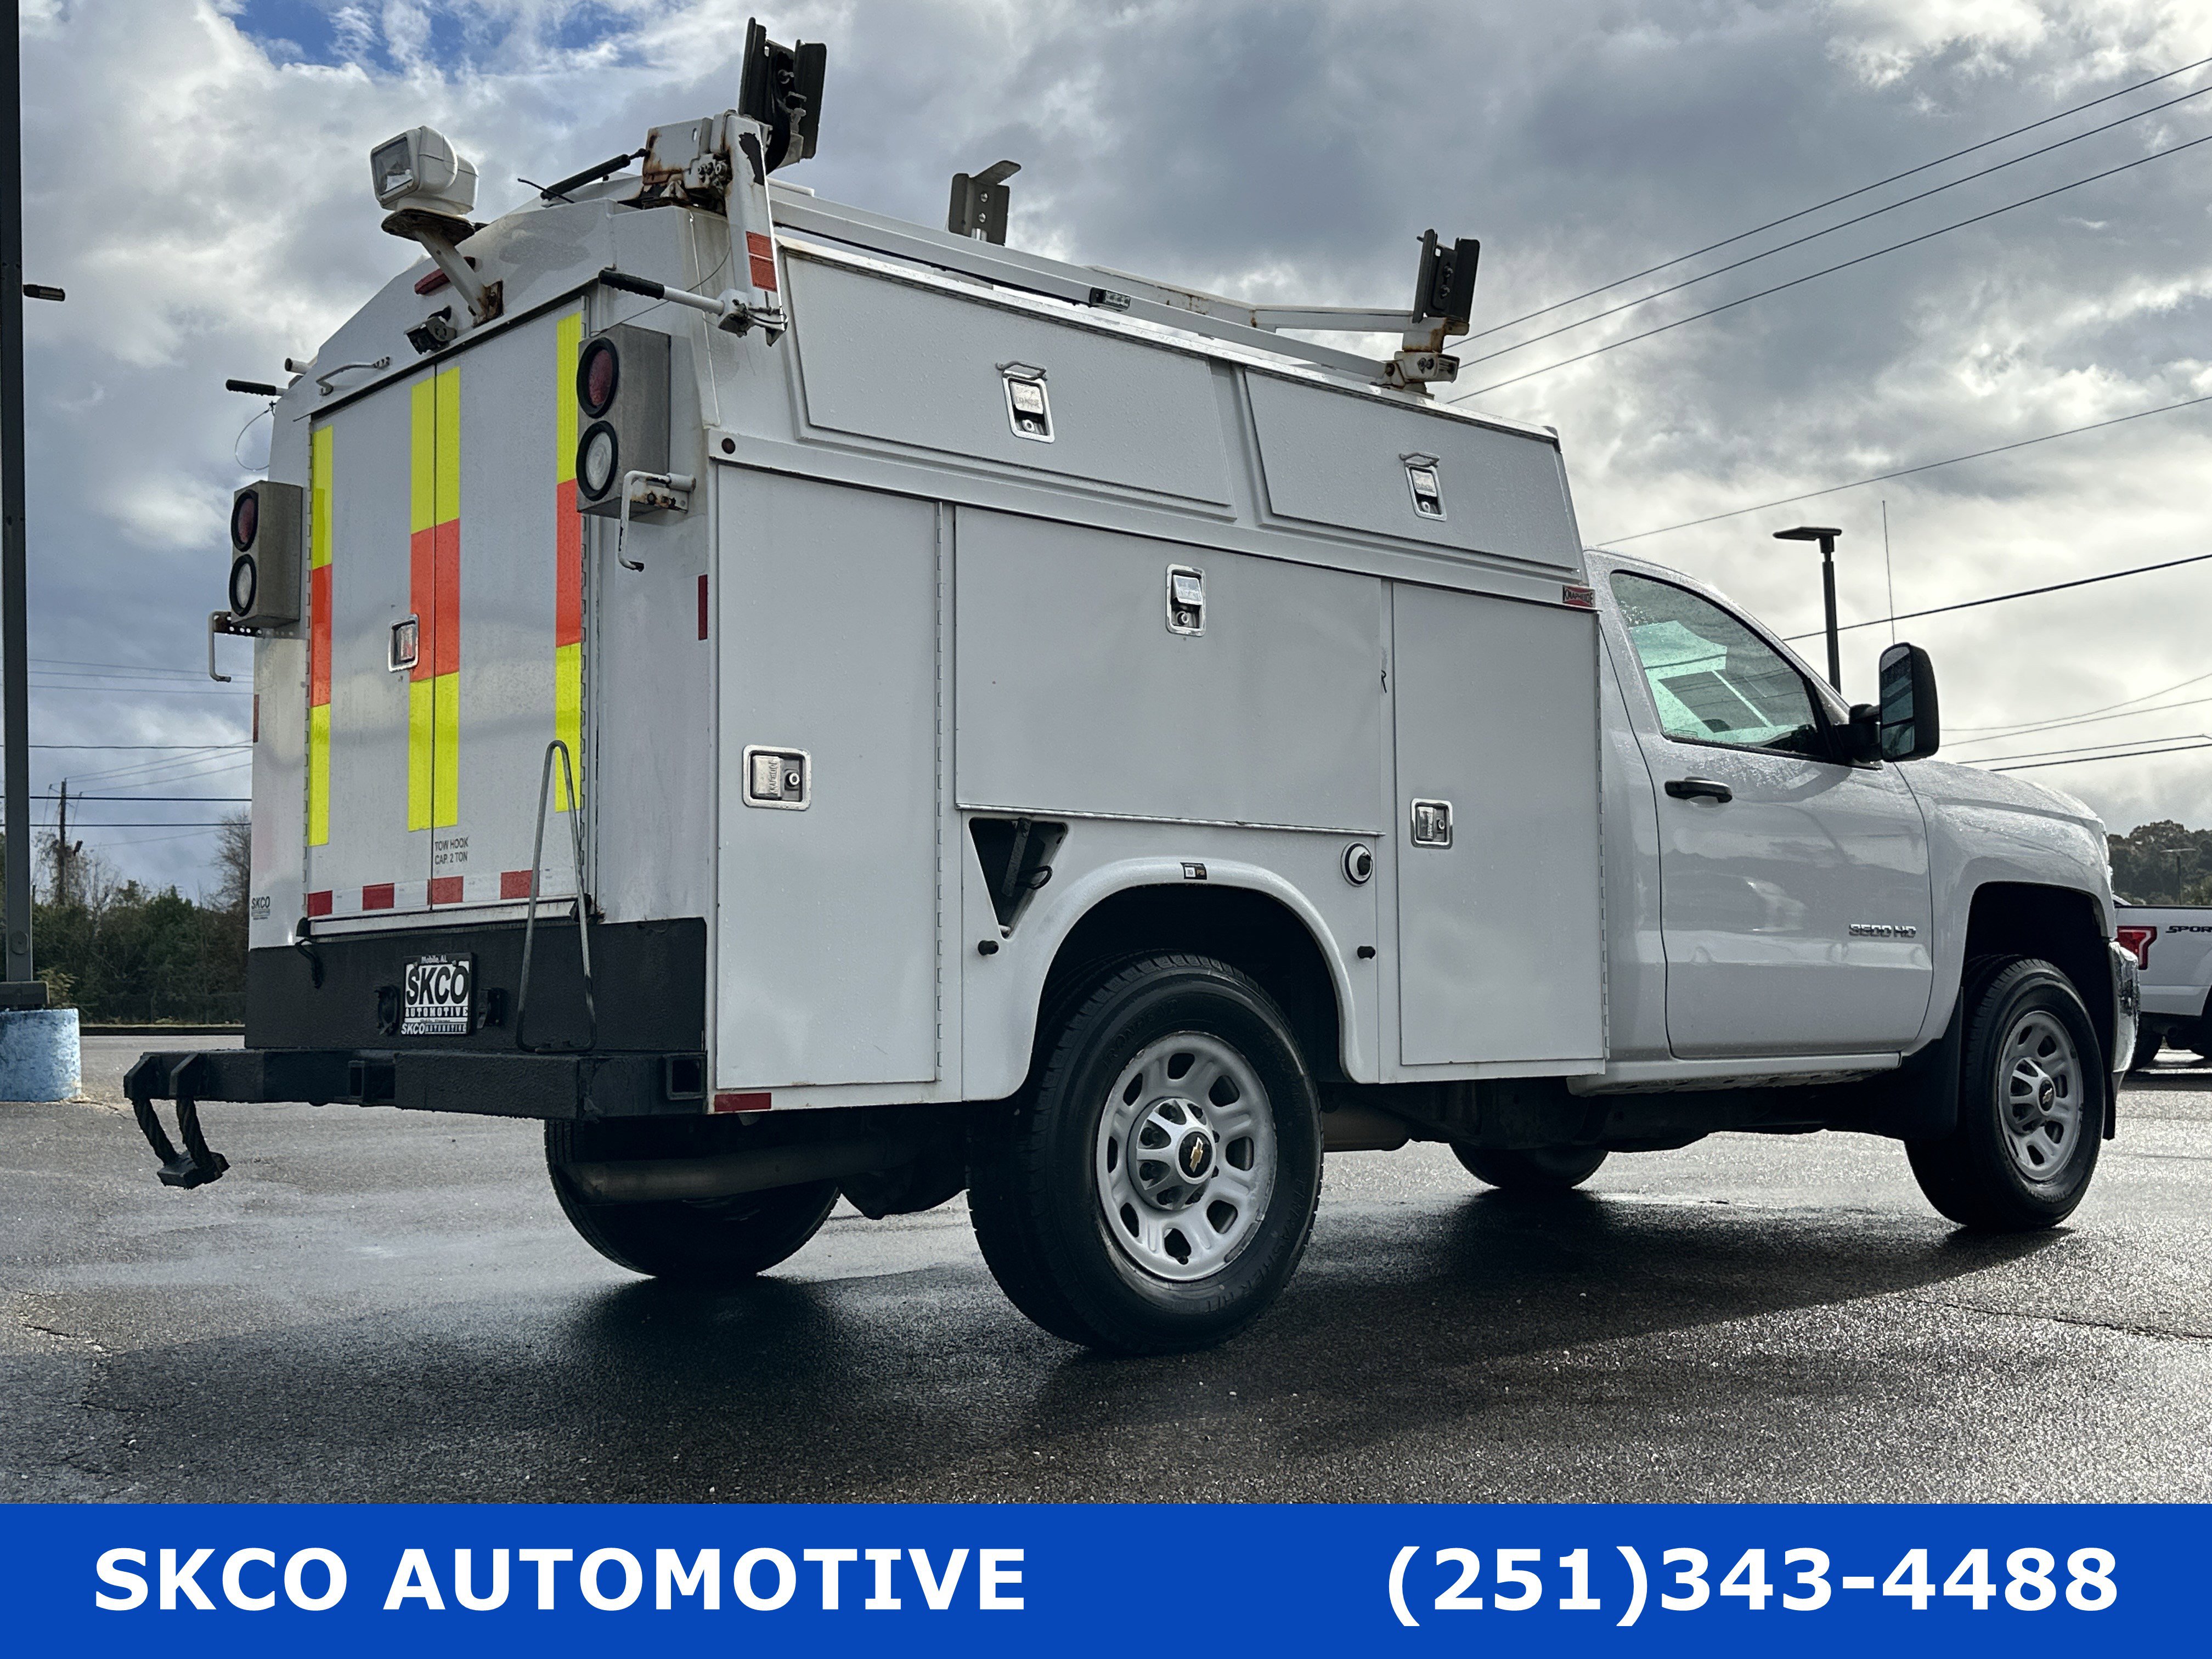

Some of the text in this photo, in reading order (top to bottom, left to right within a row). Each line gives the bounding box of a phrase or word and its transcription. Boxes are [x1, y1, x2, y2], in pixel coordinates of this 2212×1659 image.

[435, 837, 469, 851] TOW HOOK
[450, 853, 454, 863] 2
[454, 851, 468, 862] TON
[251, 896, 270, 909] SKCO
[1849, 924, 1916, 938] 3500 HD
[407, 966, 470, 1005] SKCO
[405, 1007, 468, 1017] AUTOMOTIVE
[400, 1023, 425, 1034] SKCO
